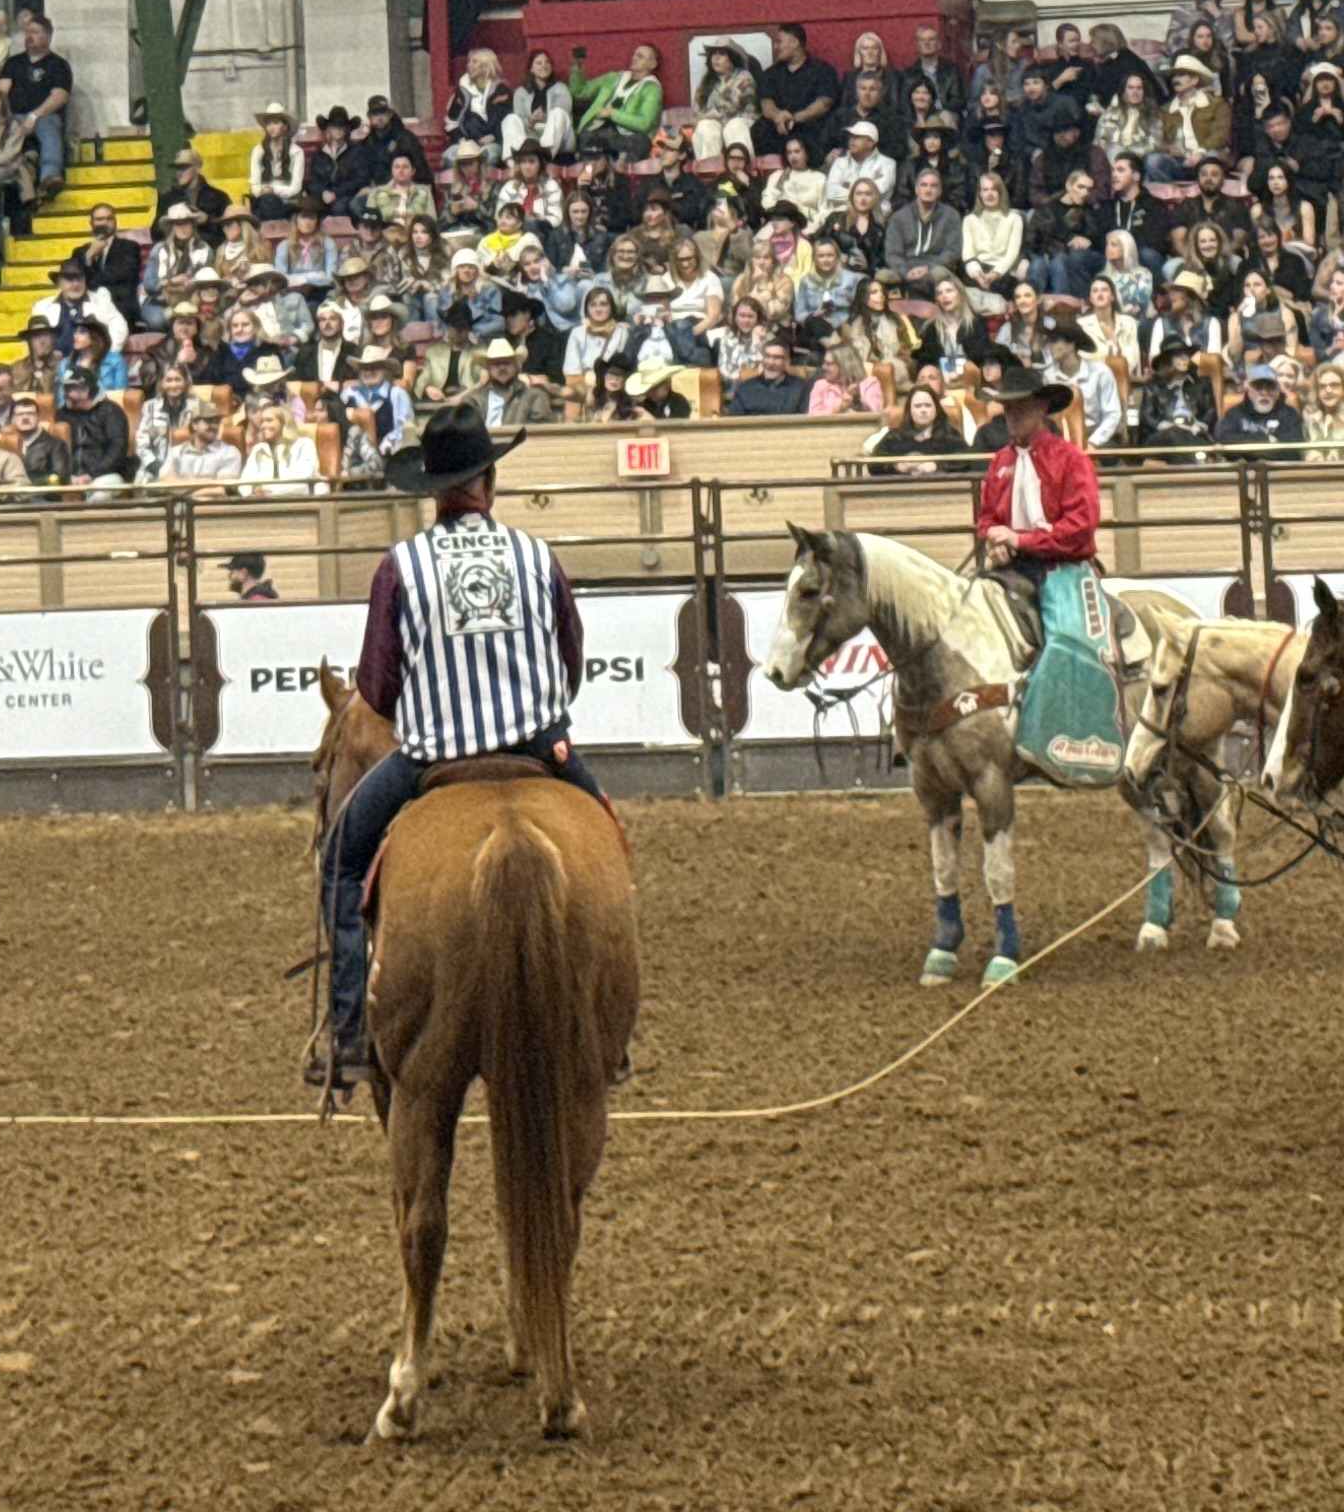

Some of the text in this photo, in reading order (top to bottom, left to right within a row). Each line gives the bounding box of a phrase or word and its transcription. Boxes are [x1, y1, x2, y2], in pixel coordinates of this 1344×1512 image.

[627, 444, 659, 469] EXIT
[436, 535, 508, 549] CINCH
[5, 692, 72, 709] CENTER
